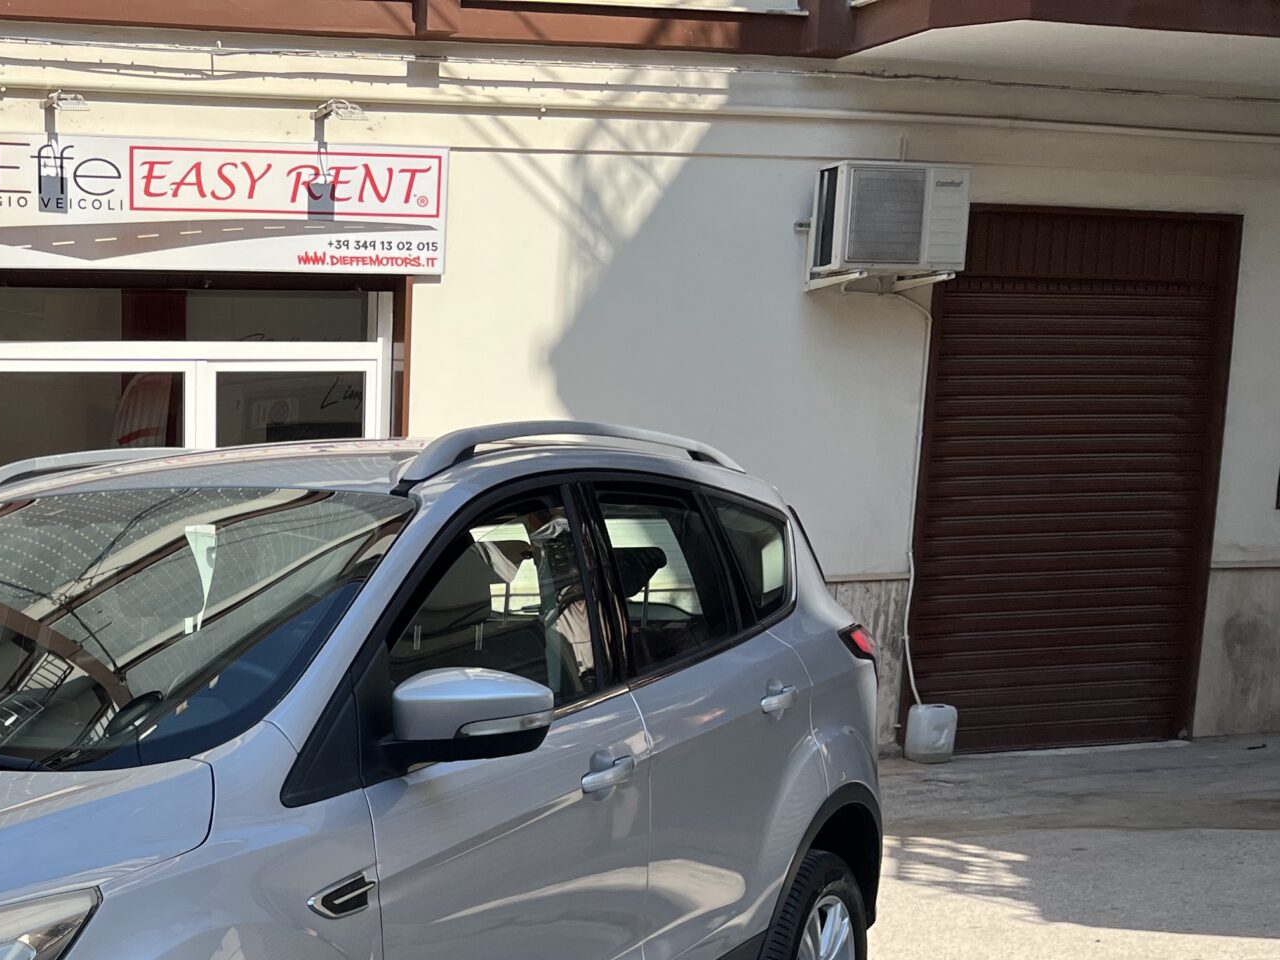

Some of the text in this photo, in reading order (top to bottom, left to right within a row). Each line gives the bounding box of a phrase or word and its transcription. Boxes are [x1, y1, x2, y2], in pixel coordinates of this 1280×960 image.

[140, 160, 272, 201] EASY
[286, 162, 432, 204] RENT
[41, 196, 123, 211] VEICOLI
[327, 239, 439, 252] +39 349 13 02 015
